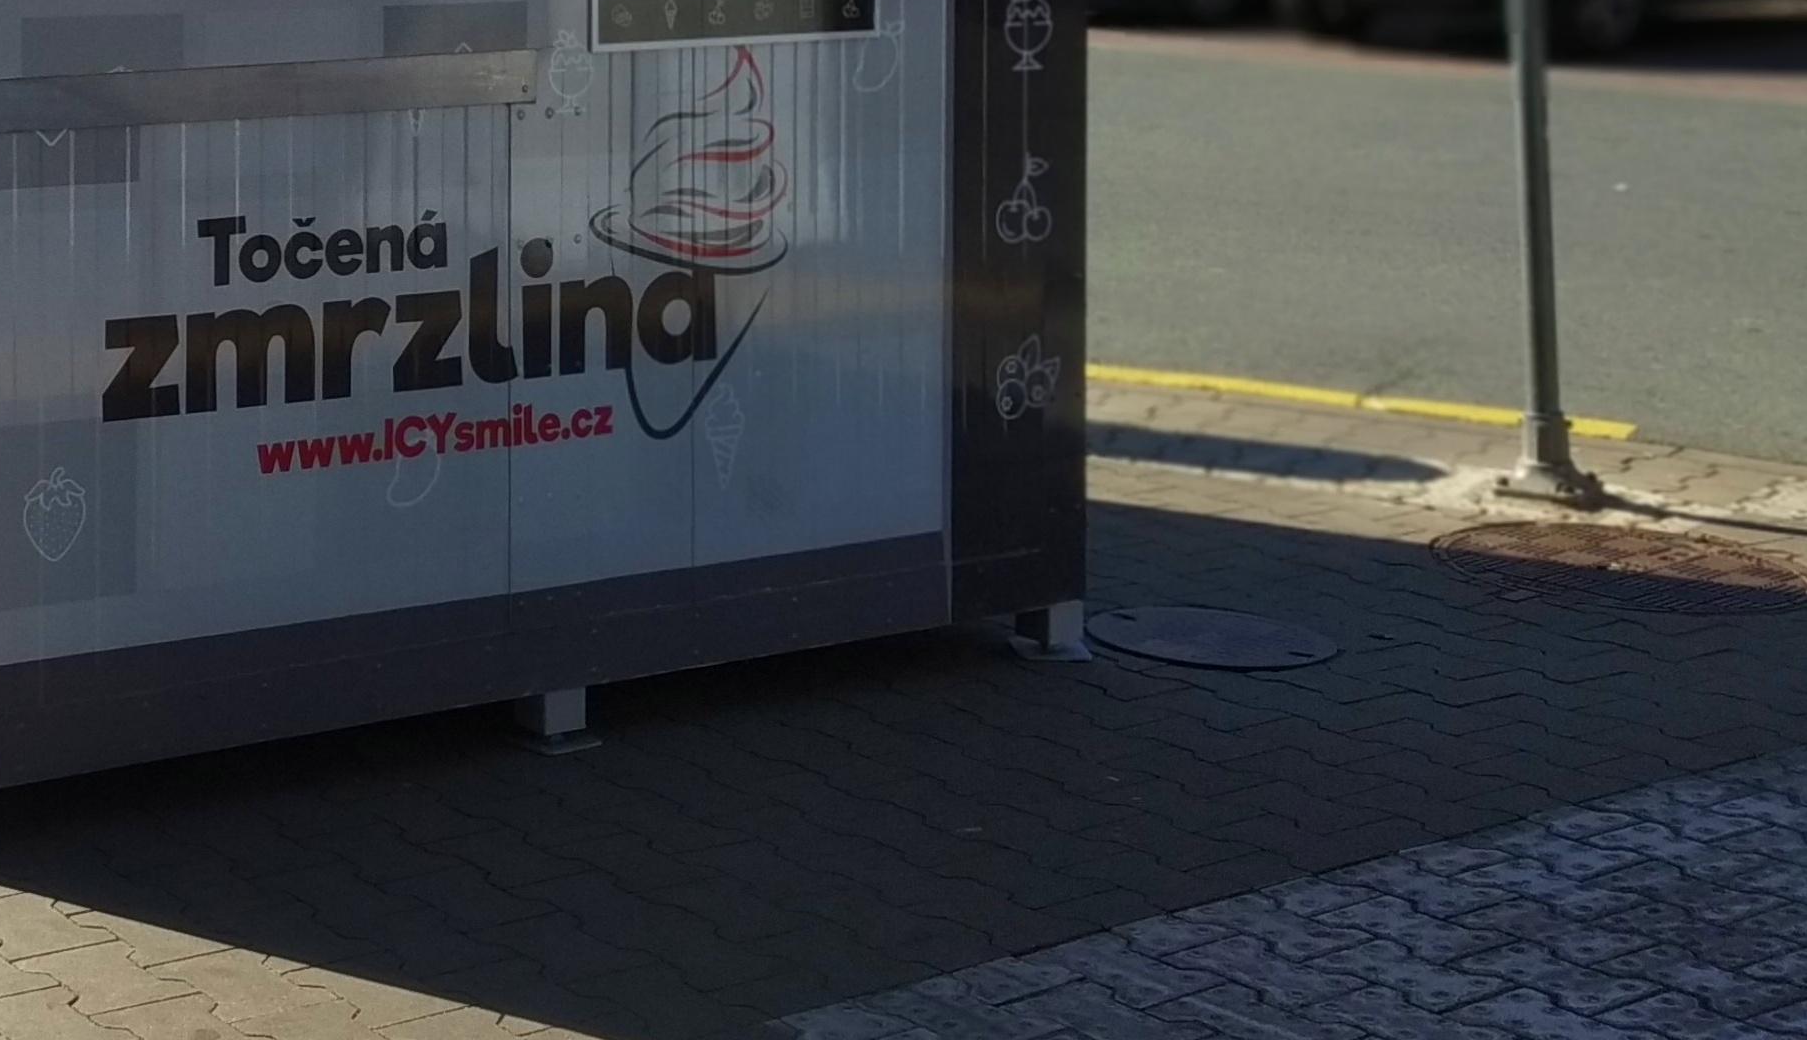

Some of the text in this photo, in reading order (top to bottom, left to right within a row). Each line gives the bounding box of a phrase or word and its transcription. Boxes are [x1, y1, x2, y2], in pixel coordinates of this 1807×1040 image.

[197, 210, 449, 287] Točená
[102, 237, 718, 423] zmrzlina
[257, 403, 613, 474] www.ICYsmile.cz
